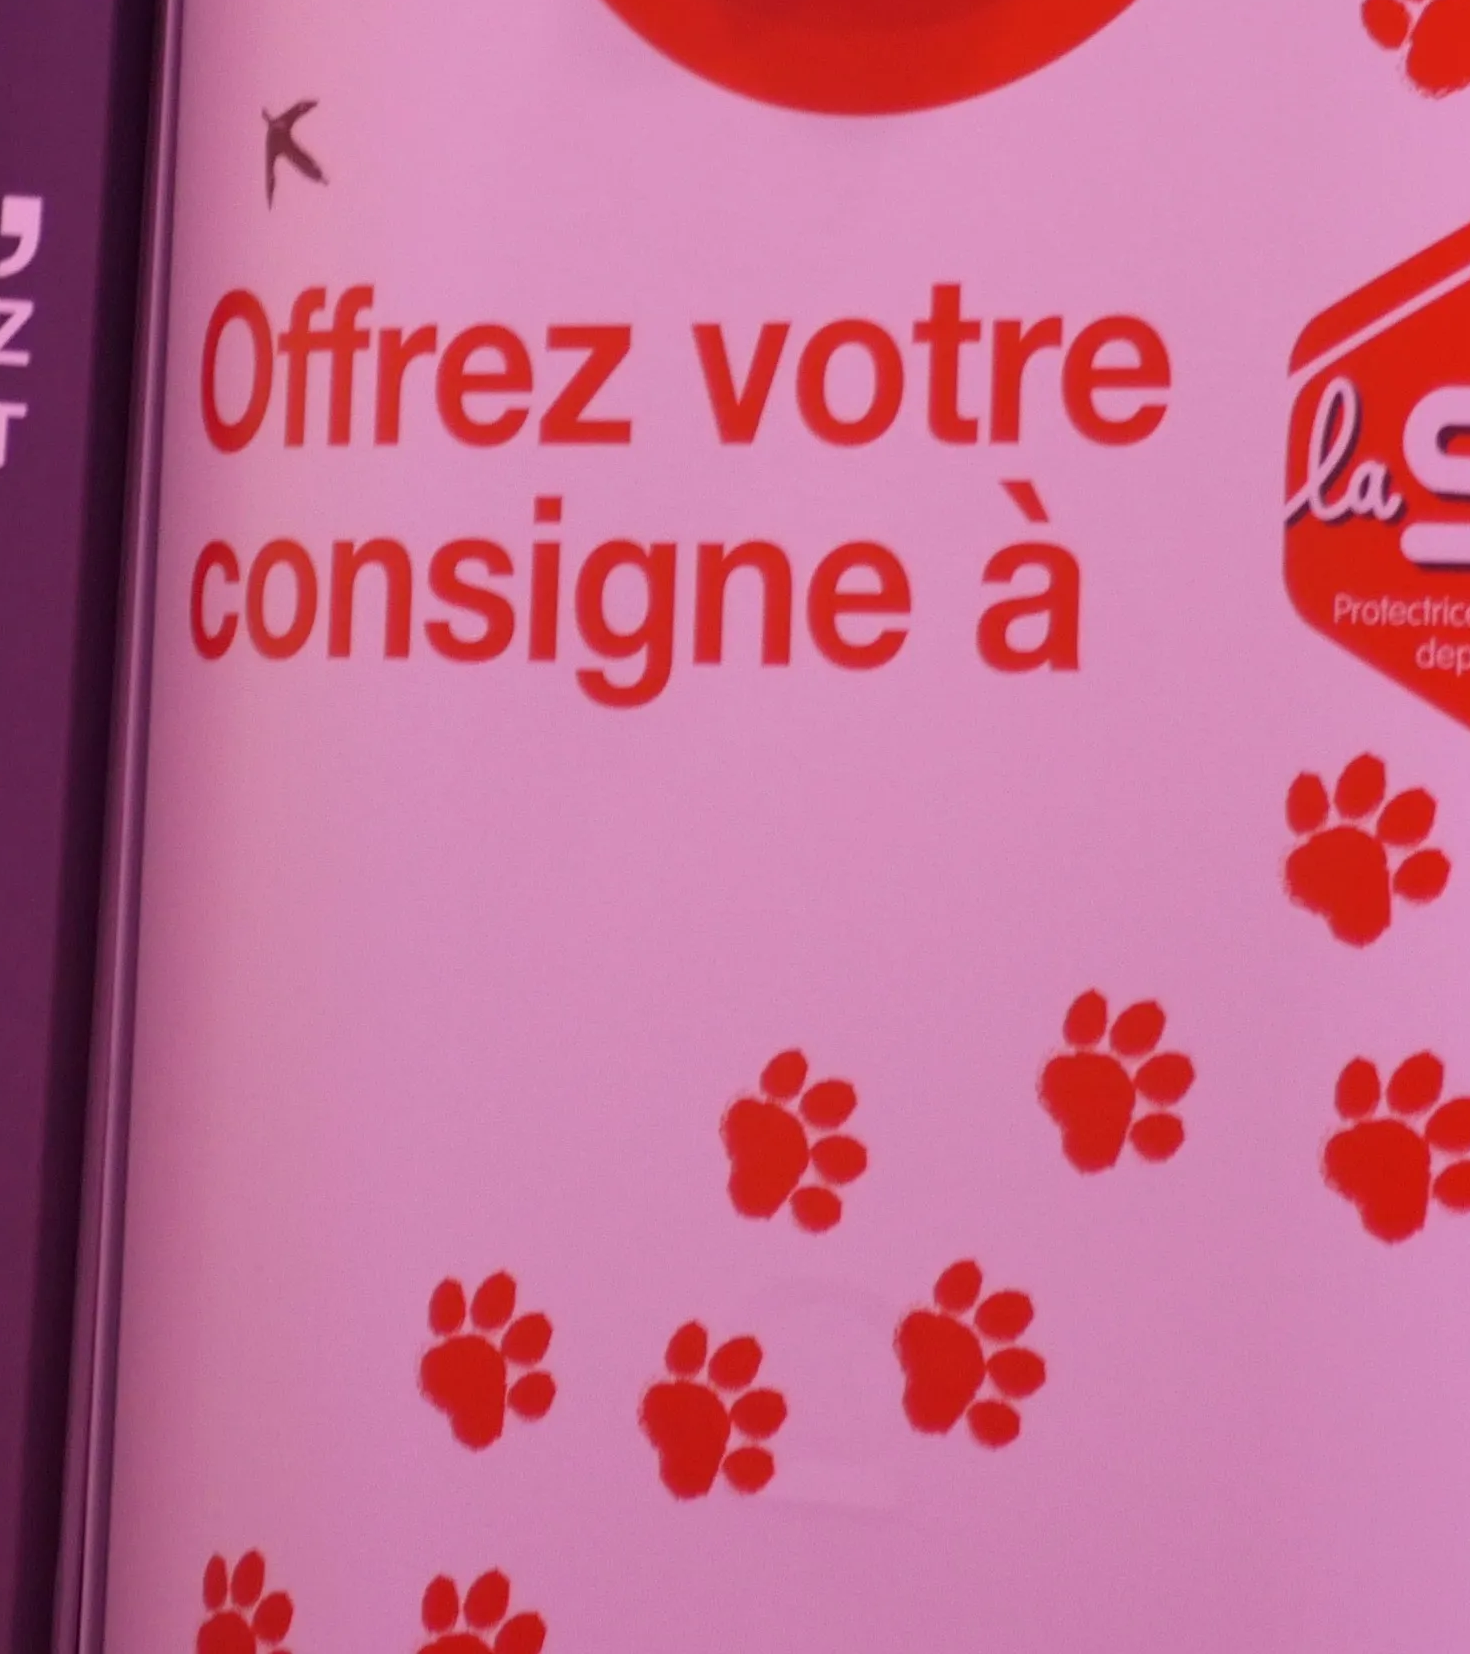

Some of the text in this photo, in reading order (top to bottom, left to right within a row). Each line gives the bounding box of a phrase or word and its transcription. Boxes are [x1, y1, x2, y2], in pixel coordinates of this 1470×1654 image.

[200, 284, 1171, 454] Offrez votre
[1285, 377, 1403, 521] la
[189, 481, 1080, 708] consigne à
